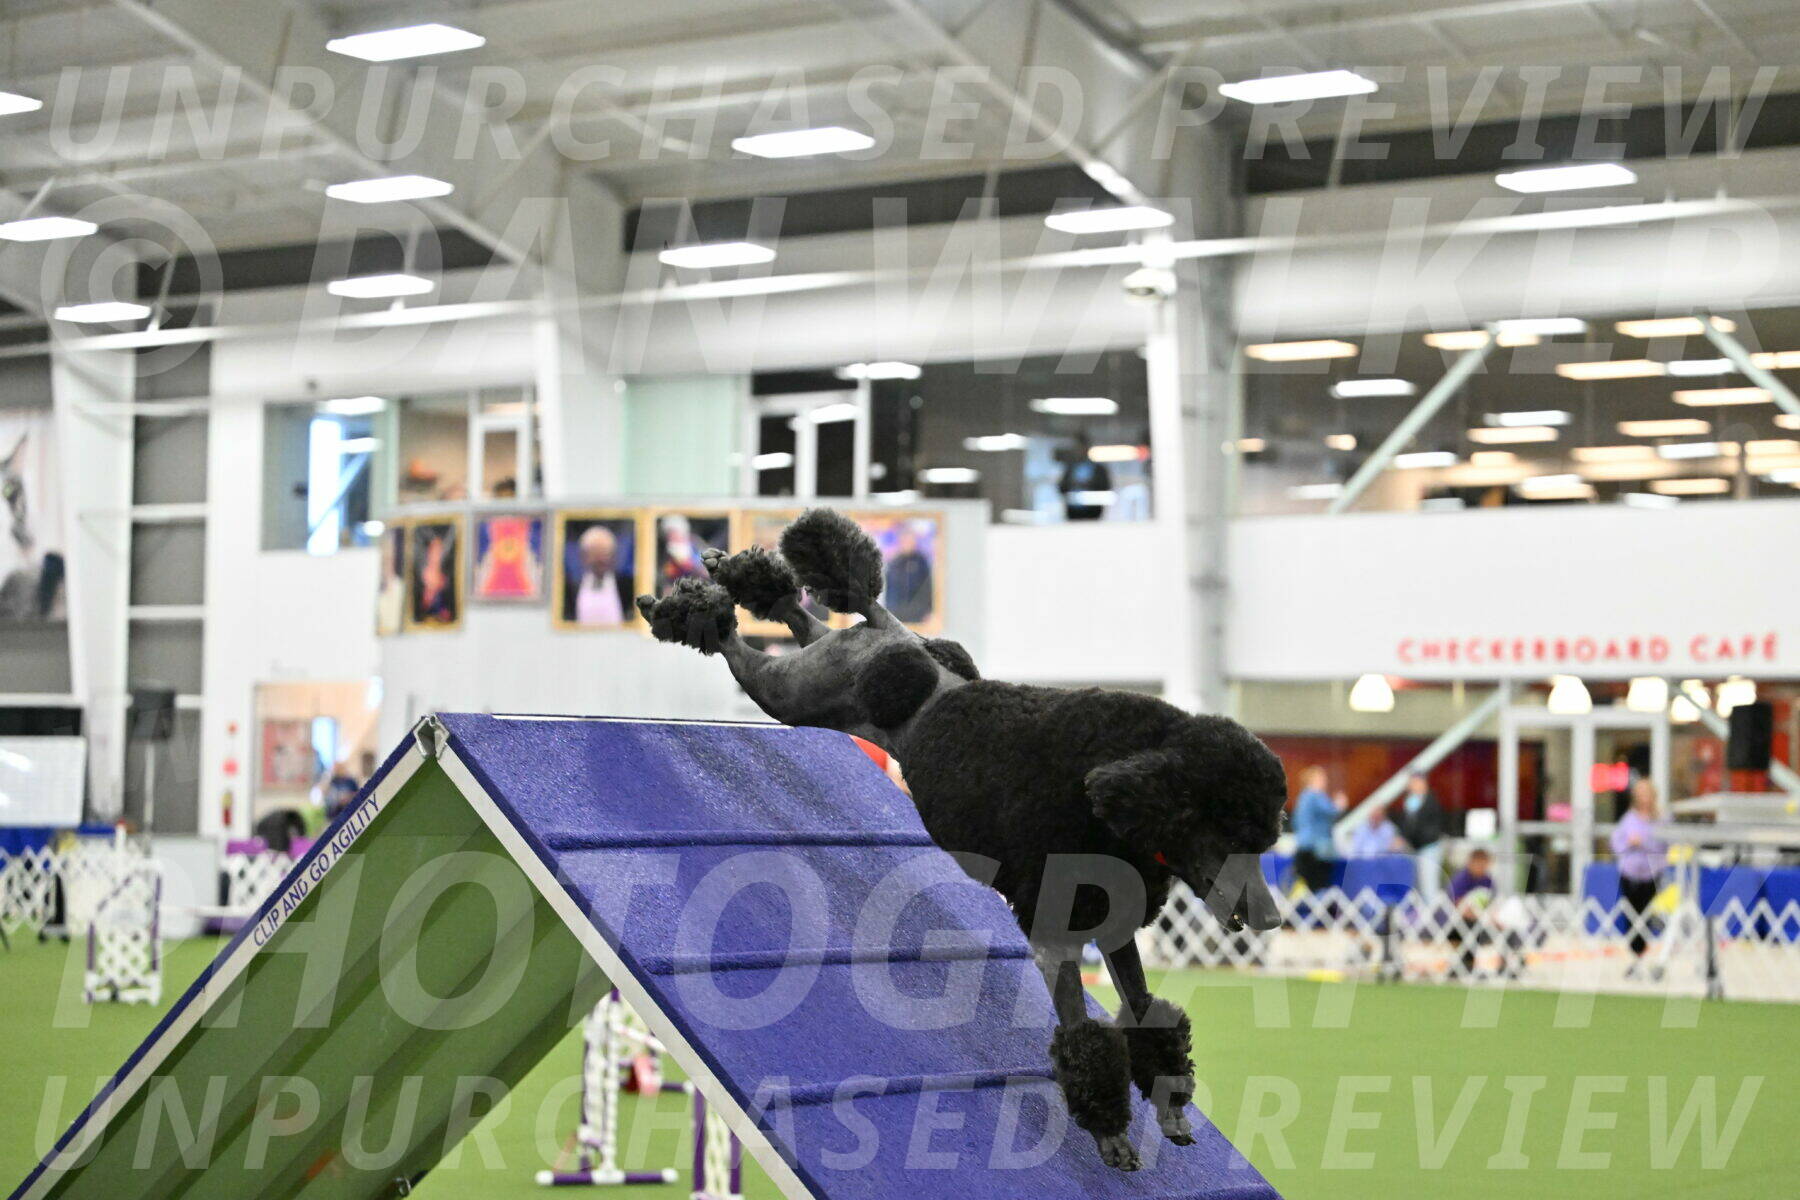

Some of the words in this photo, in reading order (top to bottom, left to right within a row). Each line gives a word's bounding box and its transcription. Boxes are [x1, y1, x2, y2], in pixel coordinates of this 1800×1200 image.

[1398, 637, 1670, 663] CHECKERBOARD
[1690, 632, 1779, 662] CAFÉ
[253, 910, 282, 947] CLIP
[282, 879, 309, 917] AND
[309, 853, 330, 882] GO
[331, 793, 381, 860] AGILITY
